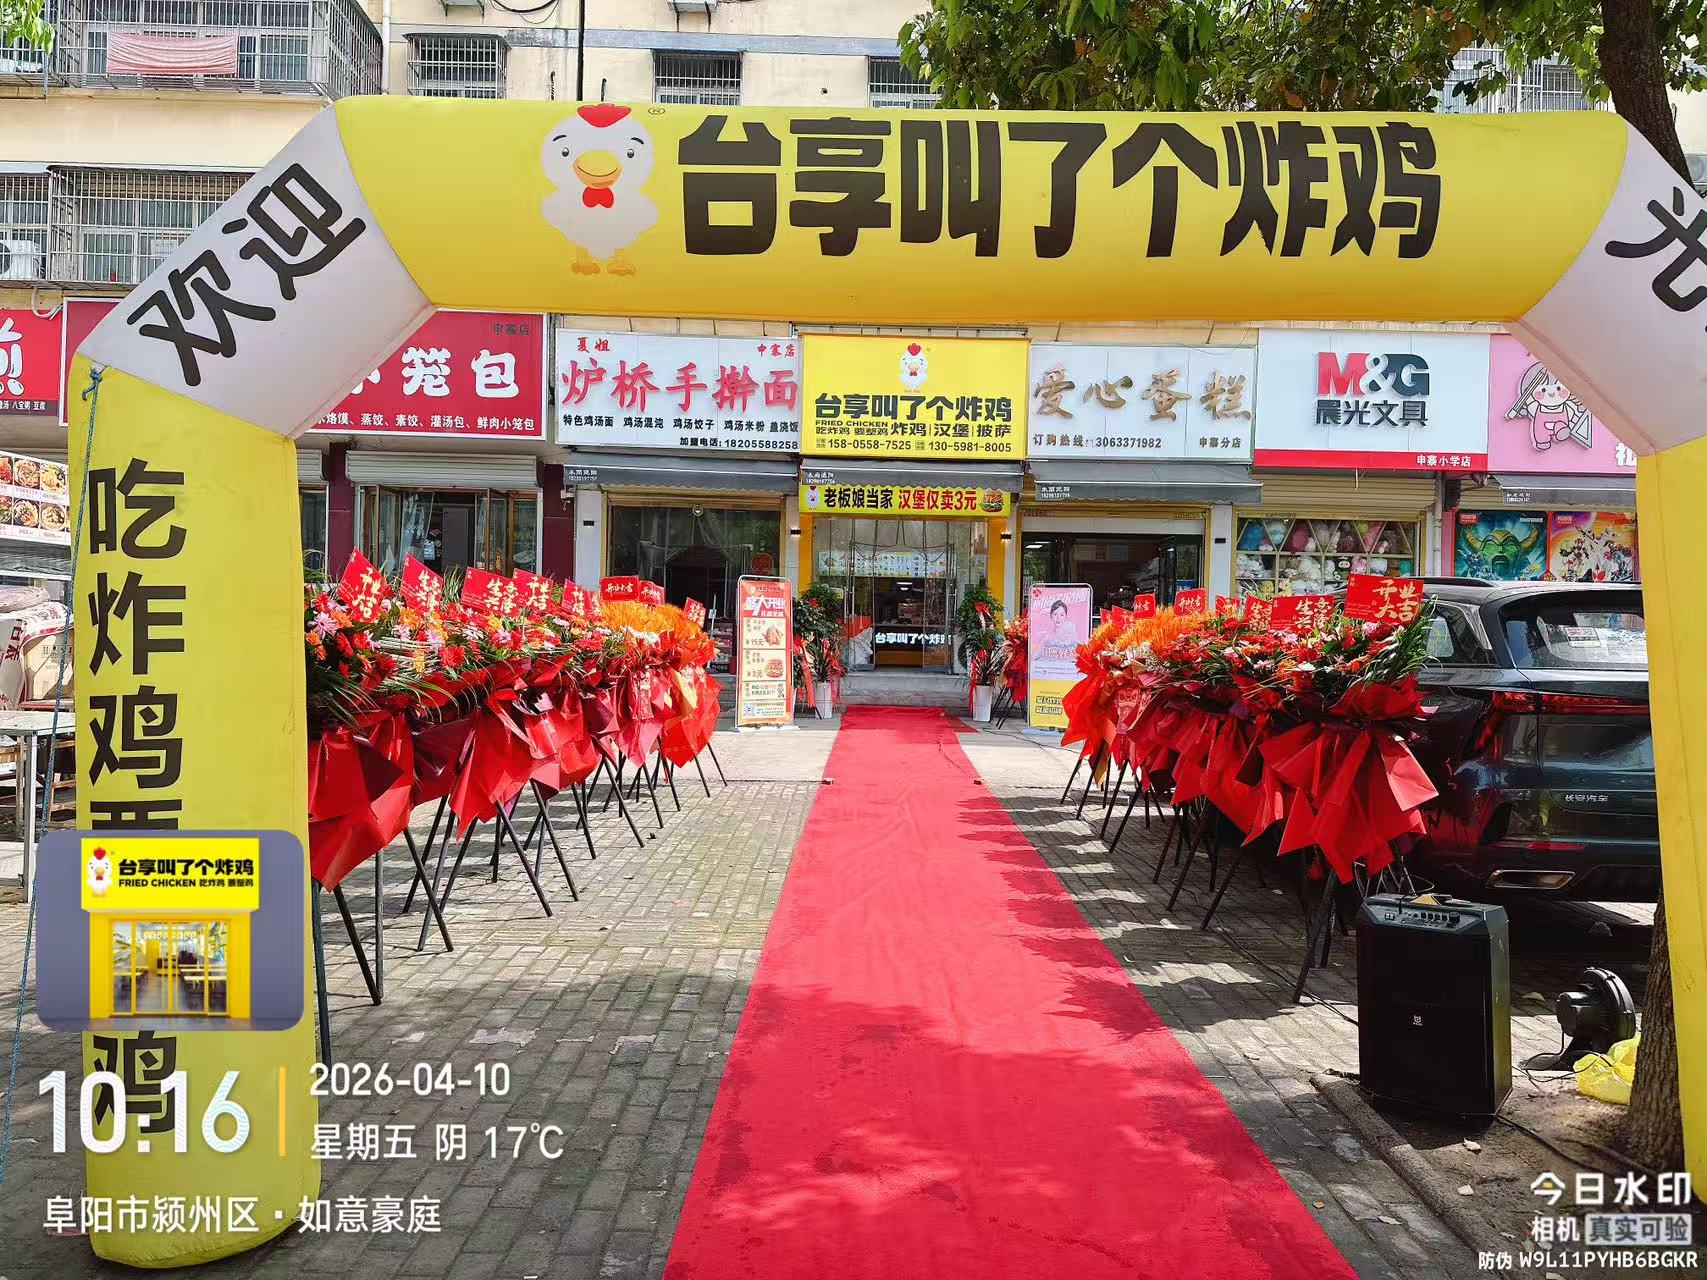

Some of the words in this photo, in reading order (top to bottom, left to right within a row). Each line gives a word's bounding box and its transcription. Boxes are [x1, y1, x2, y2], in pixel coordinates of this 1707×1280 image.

[677, 114, 1442, 258] 台享叫了个炸鸡
[126, 163, 366, 387] 欢迎
[351, 347, 519, 398] 笼包
[561, 356, 799, 413] 炉桥手擀面
[1317, 351, 1430, 396] M&G
[1033, 363, 1252, 422] 爱心蛋糕
[815, 393, 1012, 422] 台享叫了个炸鸡
[1315, 399, 1429, 427] 晨光文具
[563, 414, 614, 428] 特色鸡汤面
[673, 418, 715, 431] 鸡汤饺子
[724, 420, 766, 433] 鸡汤米粉
[891, 423, 927, 437] 炸鸡
[933, 423, 969, 437] 汉堡
[976, 424, 1011, 438] 披萨
[828, 439, 912, 450] 158-0558-7525
[928, 440, 1012, 452] 130-5981-8005
[1199, 436, 1241, 448] 申寨分店
[1417, 455, 1471, 467] 申寨小学店
[824, 487, 894, 510] 老板娘当家
[898, 489, 977, 511] 汉堡仅卖3元
